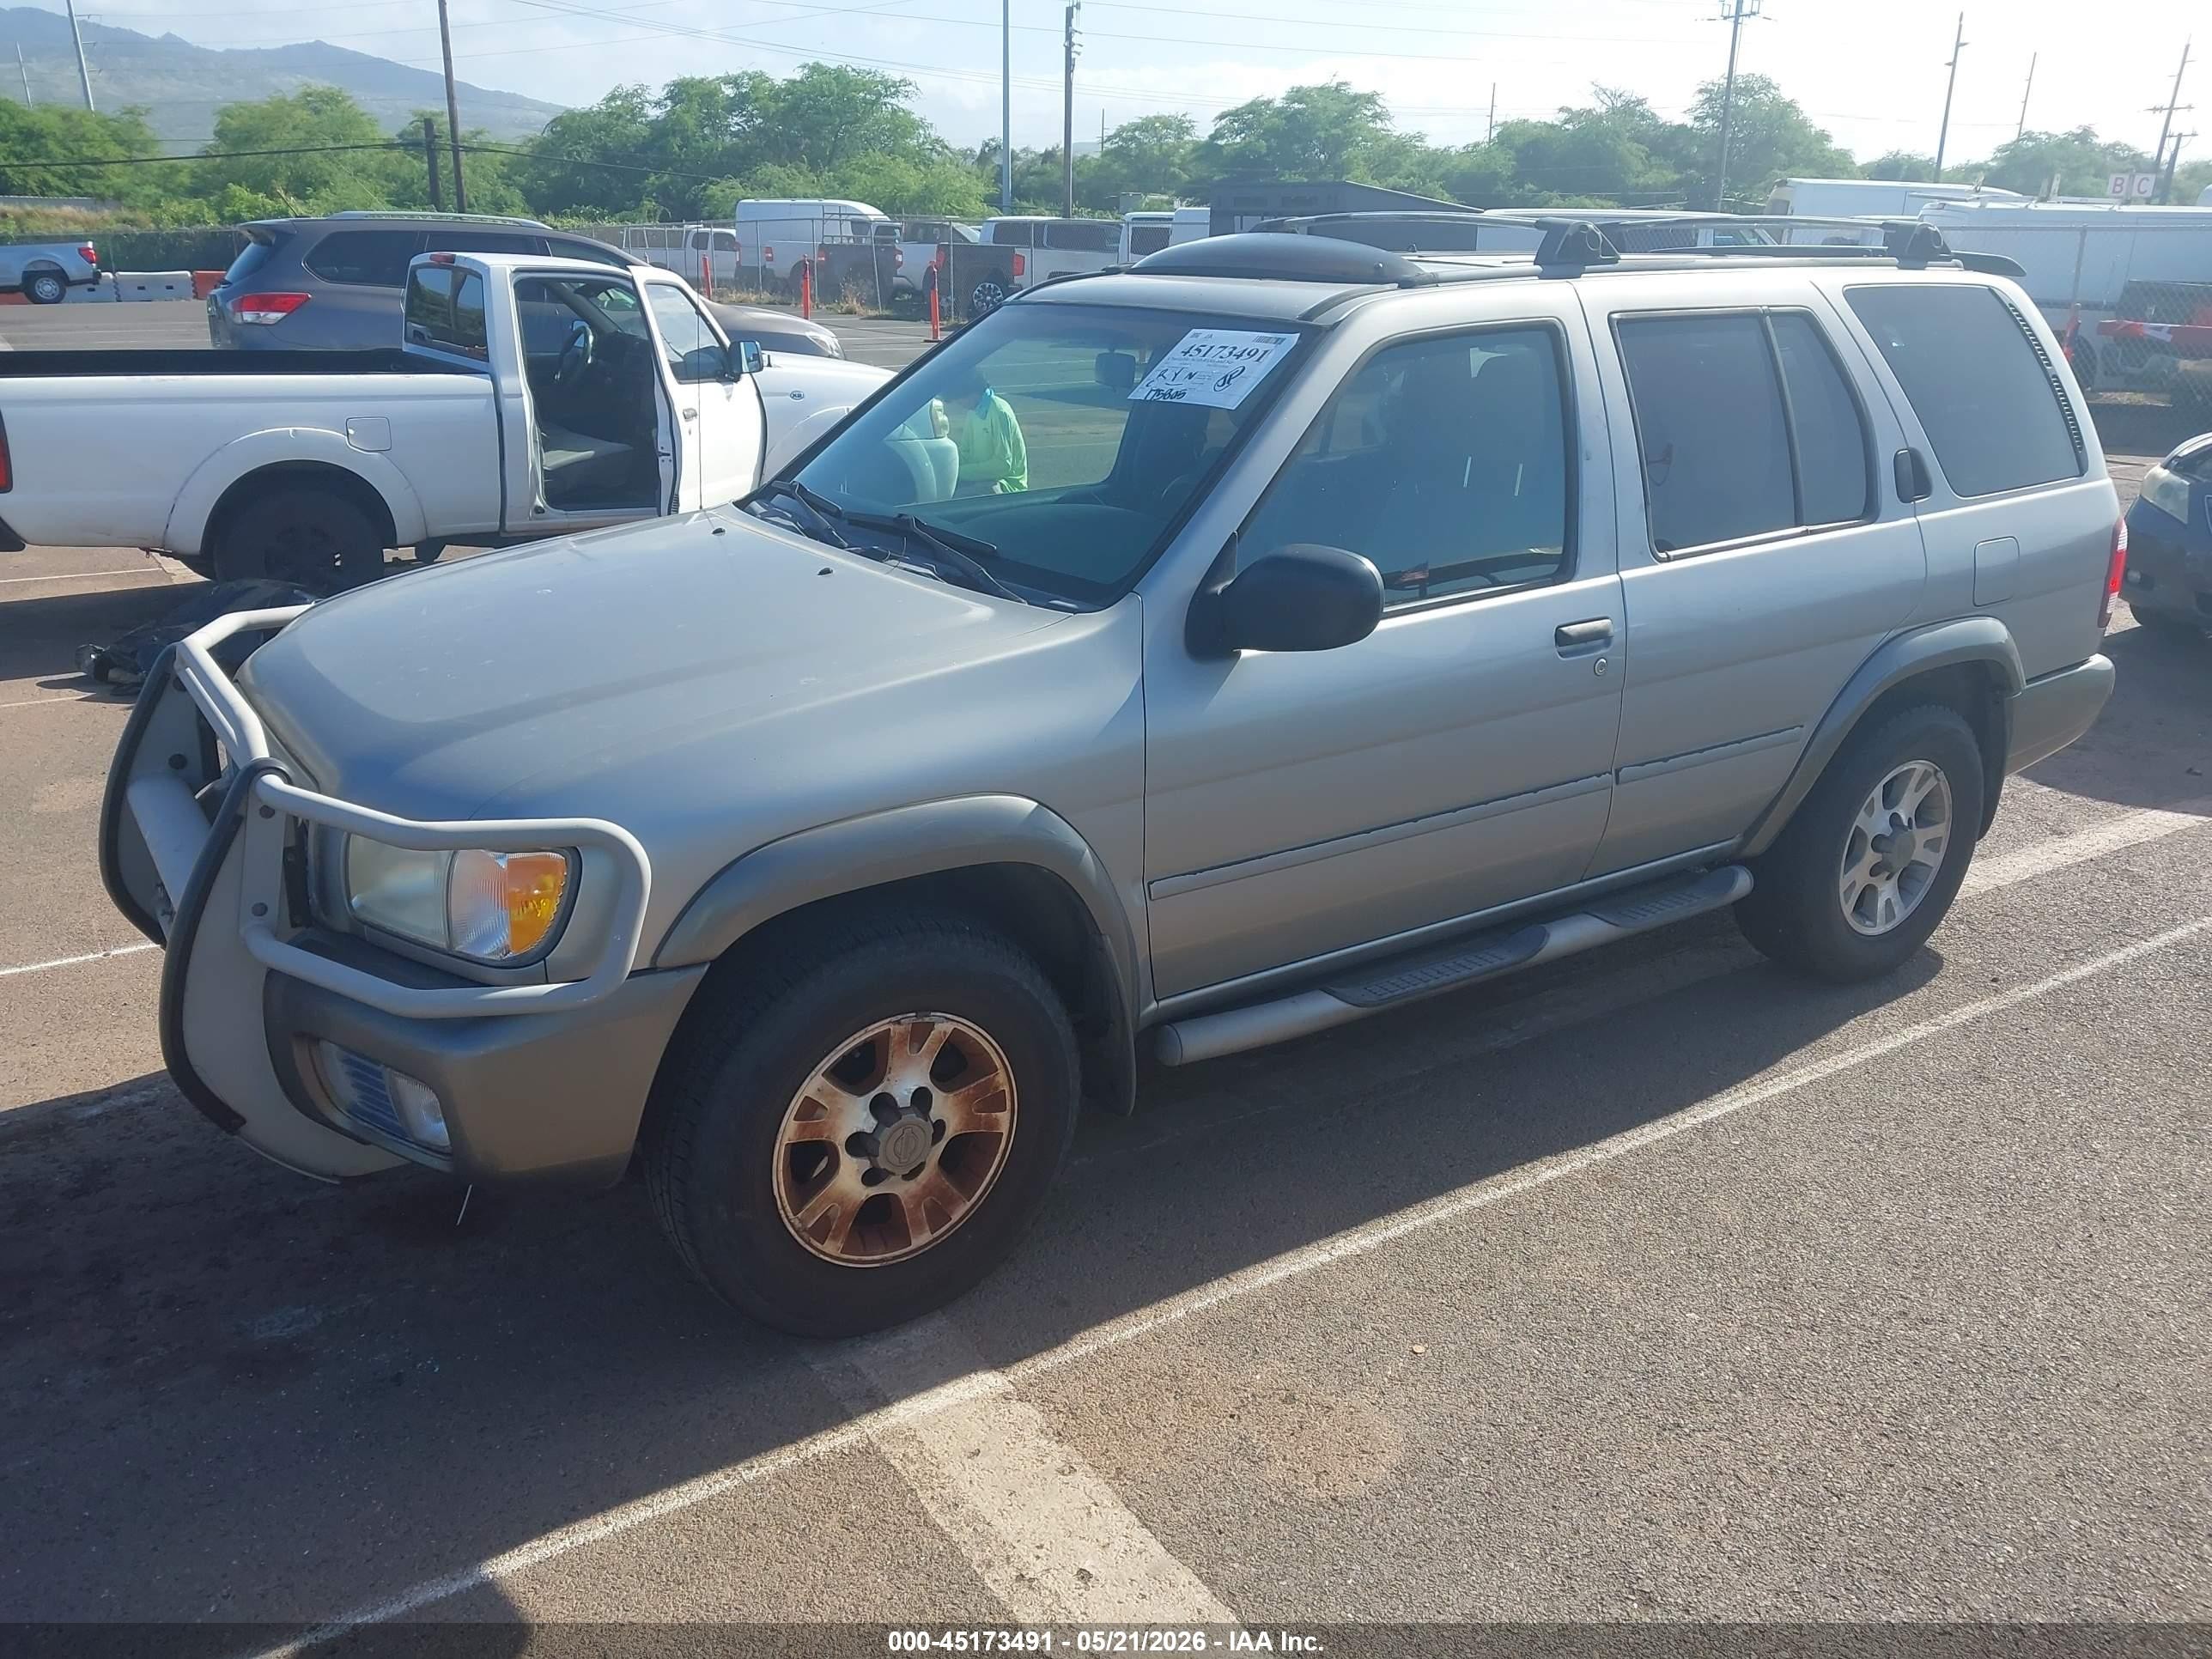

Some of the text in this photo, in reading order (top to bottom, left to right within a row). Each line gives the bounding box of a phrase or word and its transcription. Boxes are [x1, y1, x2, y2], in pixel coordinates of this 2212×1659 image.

[2112, 177, 2124, 194] B
[2136, 177, 2149, 195] C
[1181, 343, 1271, 362] 45173491
